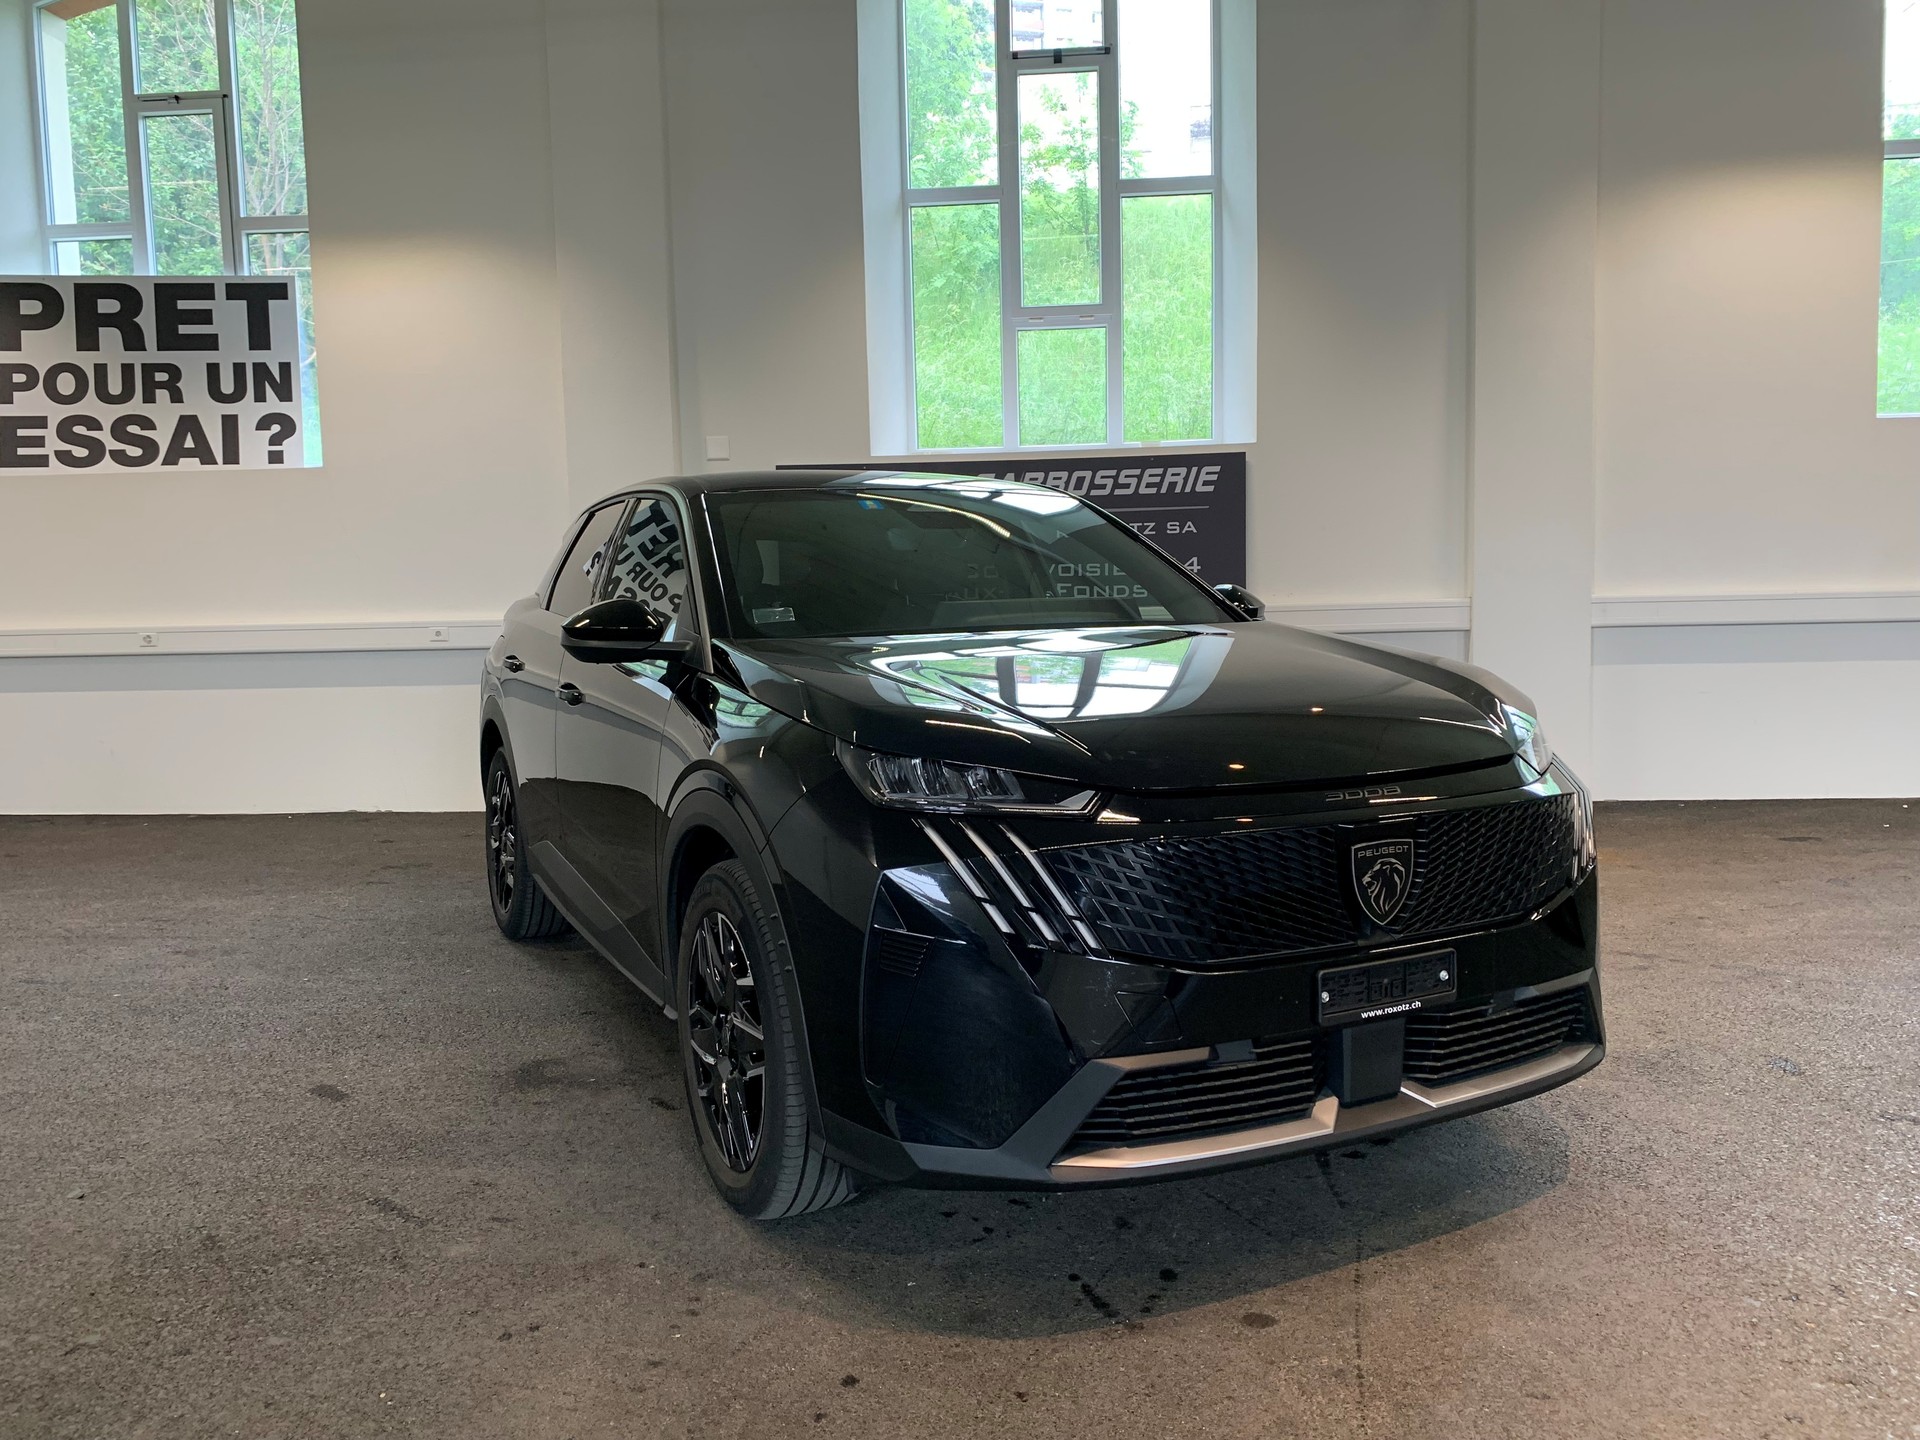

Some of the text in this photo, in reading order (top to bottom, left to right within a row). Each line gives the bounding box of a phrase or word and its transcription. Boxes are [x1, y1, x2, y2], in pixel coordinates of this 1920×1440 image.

[0, 282, 289, 352] PRET
[0, 362, 293, 405] POUR UN
[0, 413, 240, 469] ESSAI
[1166, 521, 1198, 534] SA
[1325, 786, 1401, 802] 3008
[1358, 845, 1410, 859] PEUGEOT
[1361, 1001, 1422, 1019] www.roxotz.ch
